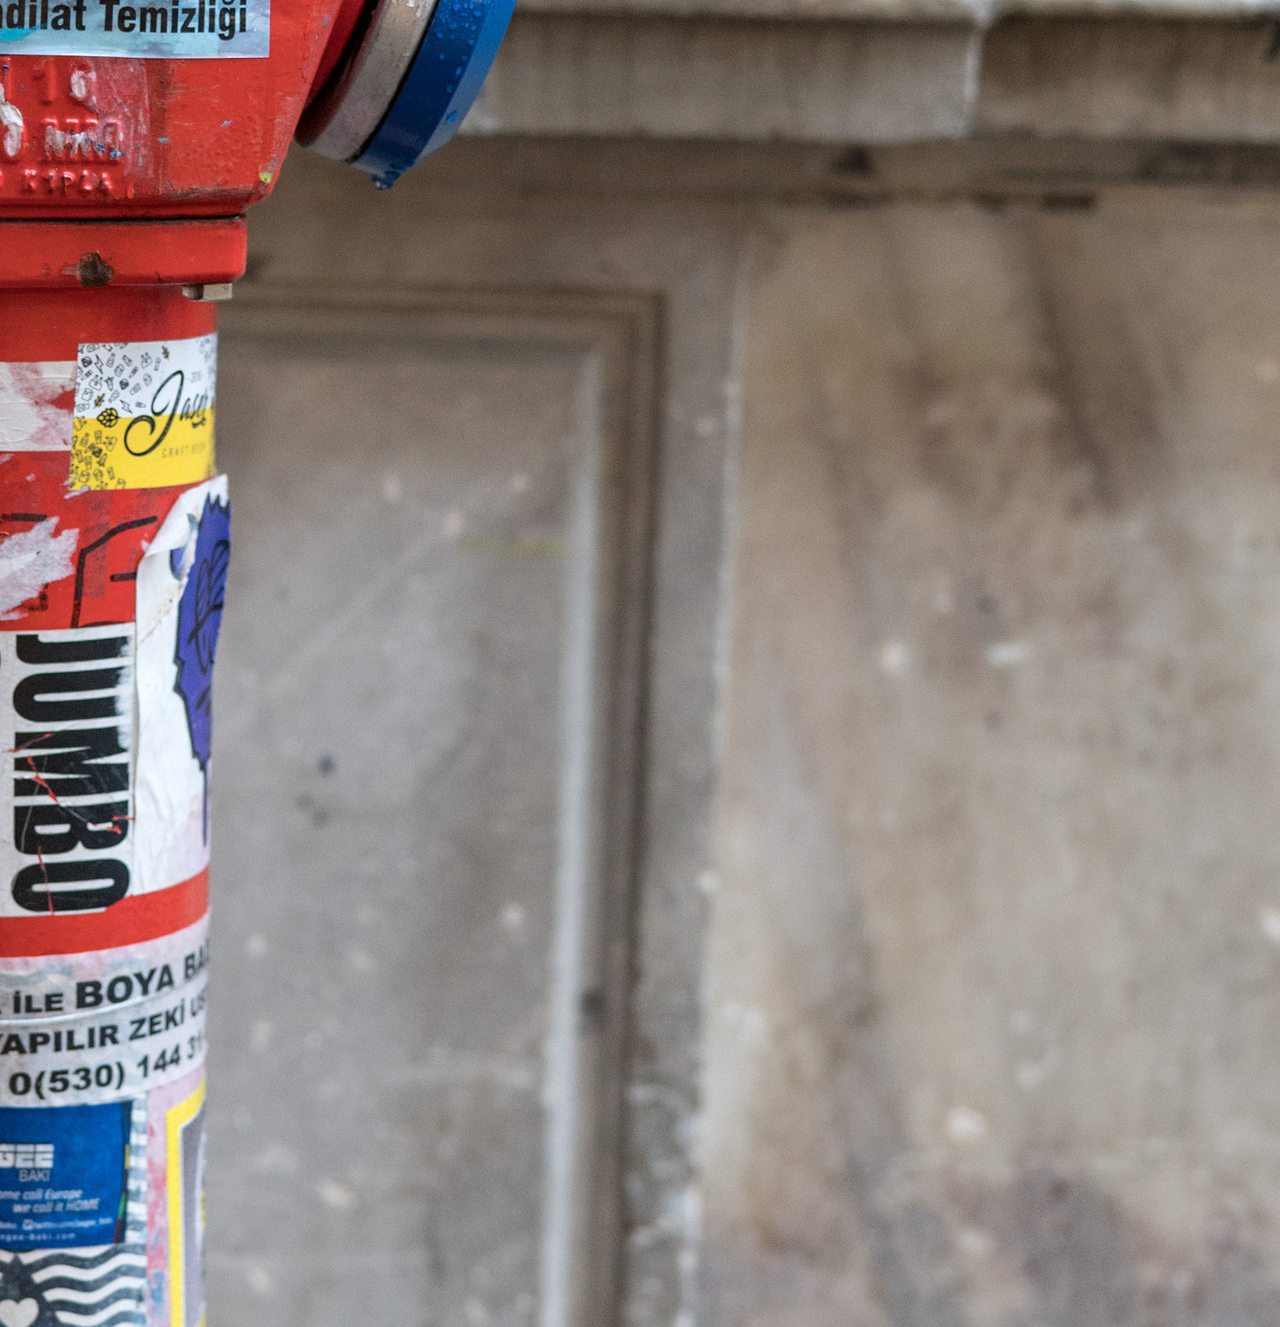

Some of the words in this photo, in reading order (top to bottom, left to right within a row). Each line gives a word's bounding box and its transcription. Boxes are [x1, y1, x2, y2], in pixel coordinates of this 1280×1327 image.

[12, 633, 131, 913] JUMBO
[13, 990, 64, 1014] İLE
[76, 964, 175, 1009] BOYA
[9, 1061, 125, 1100] 0(530)
[136, 1044, 181, 1078] 144
[44, 1188, 83, 1201] Europe
